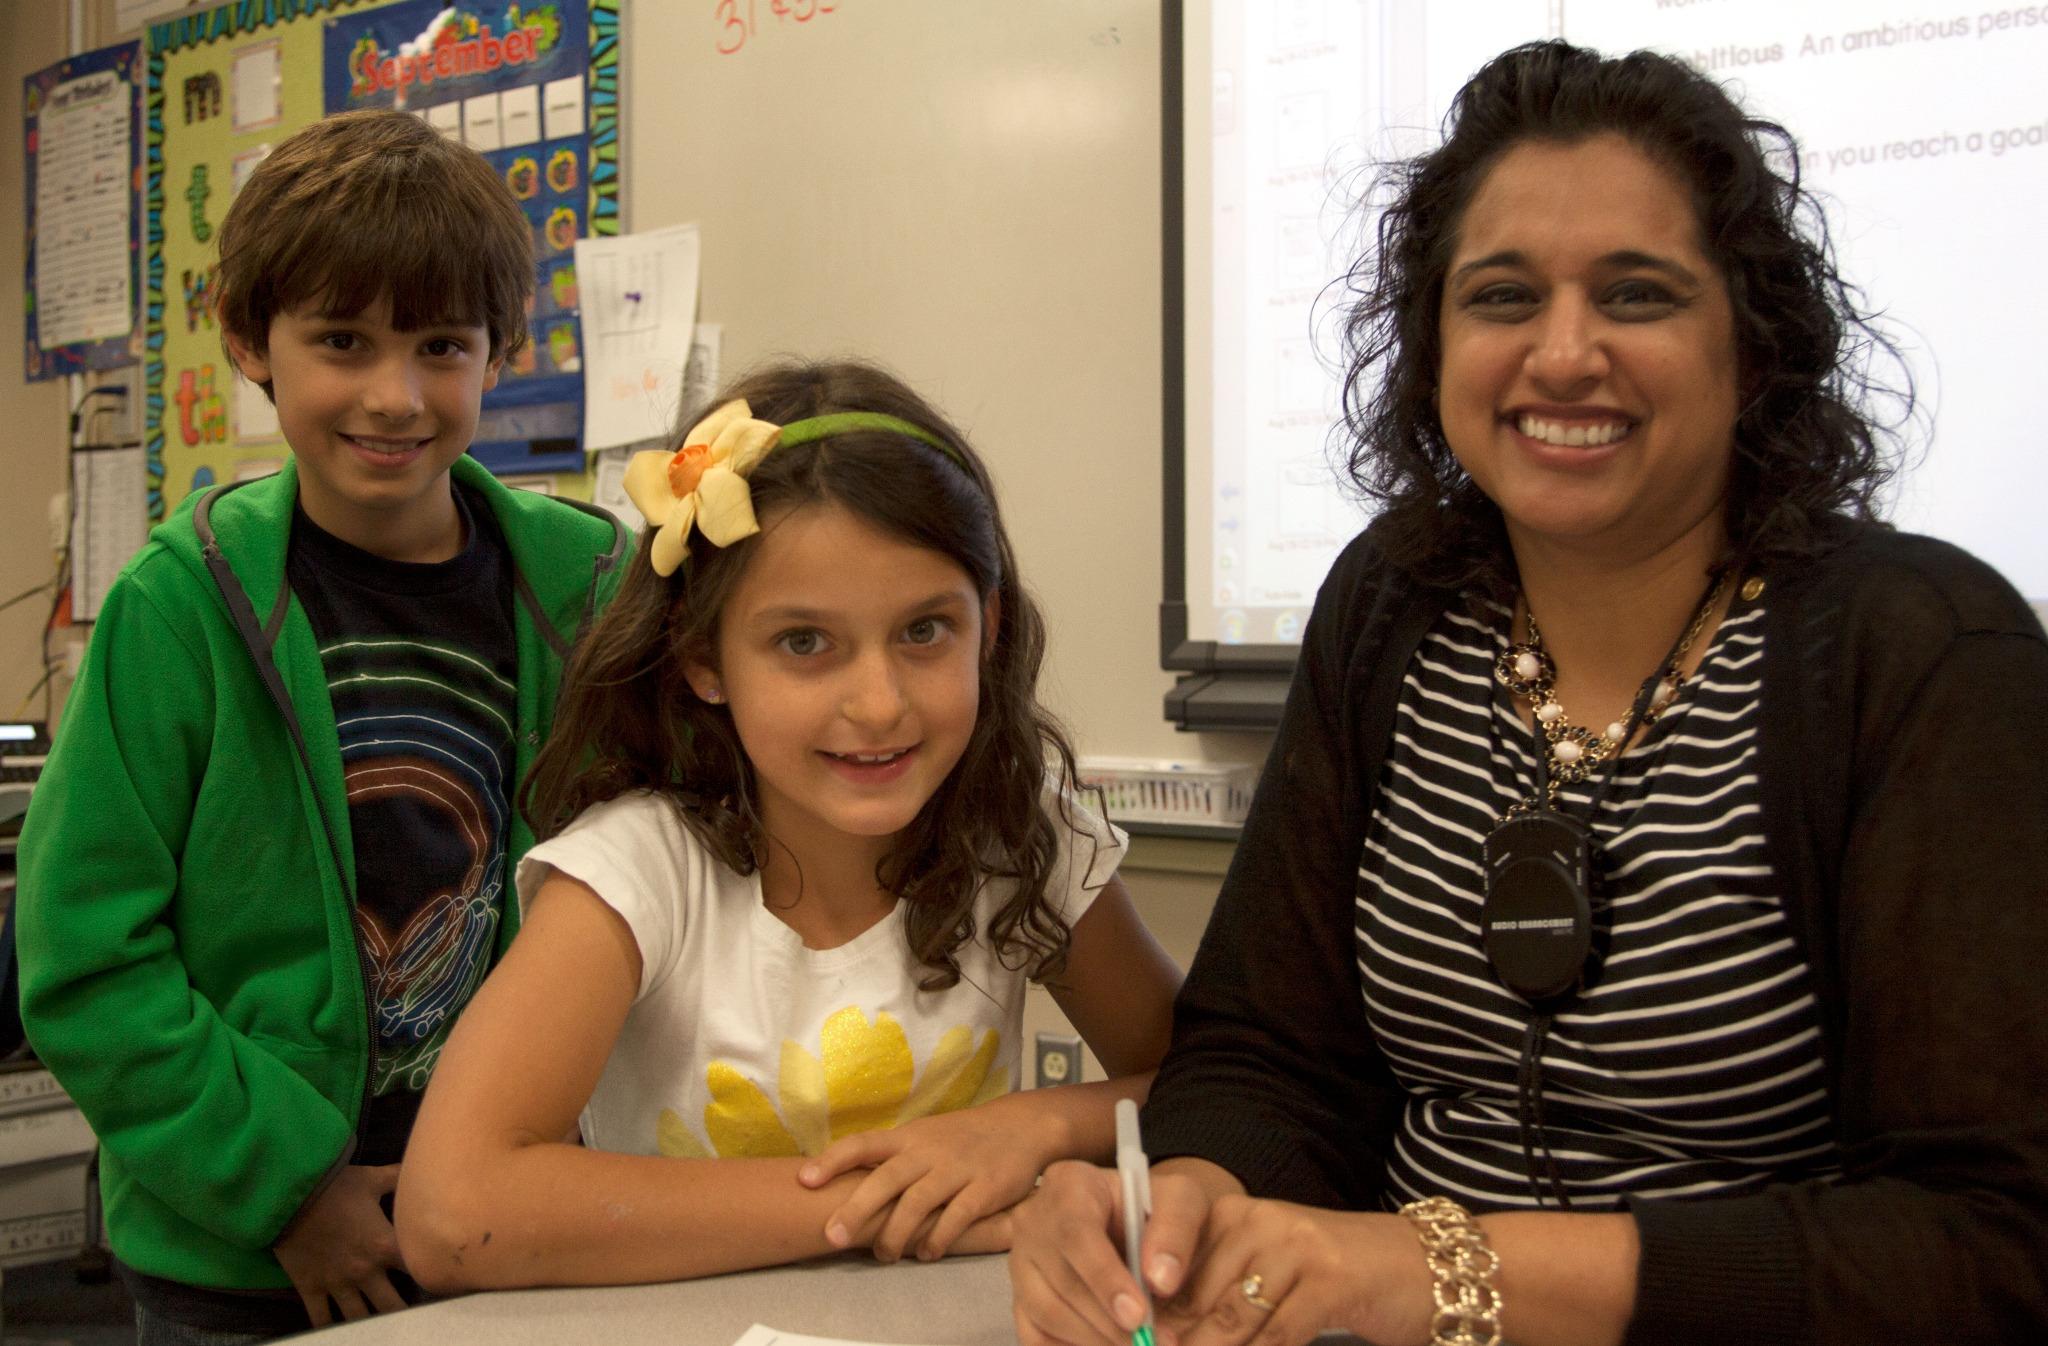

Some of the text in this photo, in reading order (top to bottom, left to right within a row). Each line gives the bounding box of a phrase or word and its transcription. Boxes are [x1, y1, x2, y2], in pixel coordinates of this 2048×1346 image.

[360, 25, 543, 103] September
[1686, 42, 1784, 71] bitious
[1800, 33, 1834, 57] An
[1841, 16, 1970, 53] ambitious
[183, 71, 223, 125] m
[1827, 145, 1876, 175] you
[1883, 132, 1959, 163] reach
[1965, 132, 1982, 152] a
[185, 163, 213, 244] t
[174, 364, 227, 447] th
